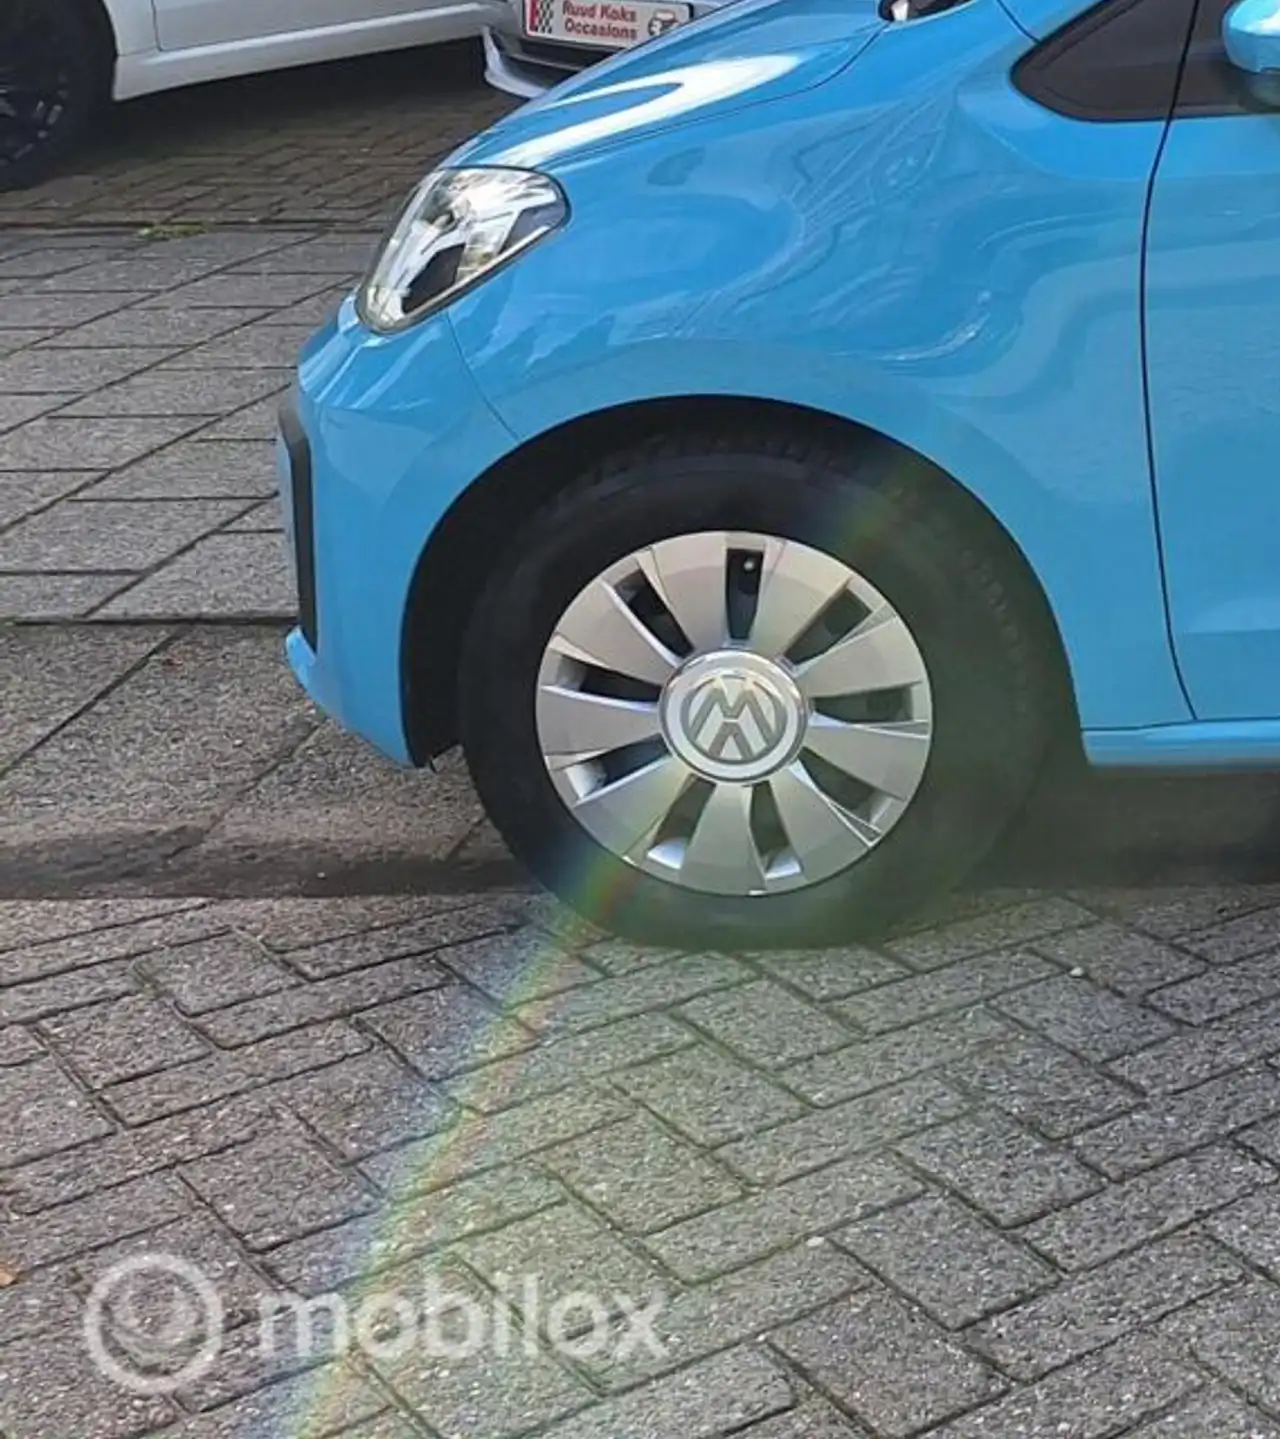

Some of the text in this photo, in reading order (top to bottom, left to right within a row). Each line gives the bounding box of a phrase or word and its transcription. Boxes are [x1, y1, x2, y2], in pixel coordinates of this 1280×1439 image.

[563, 0, 636, 21] Ruud Koks
[564, 18, 637, 39] Occasions
